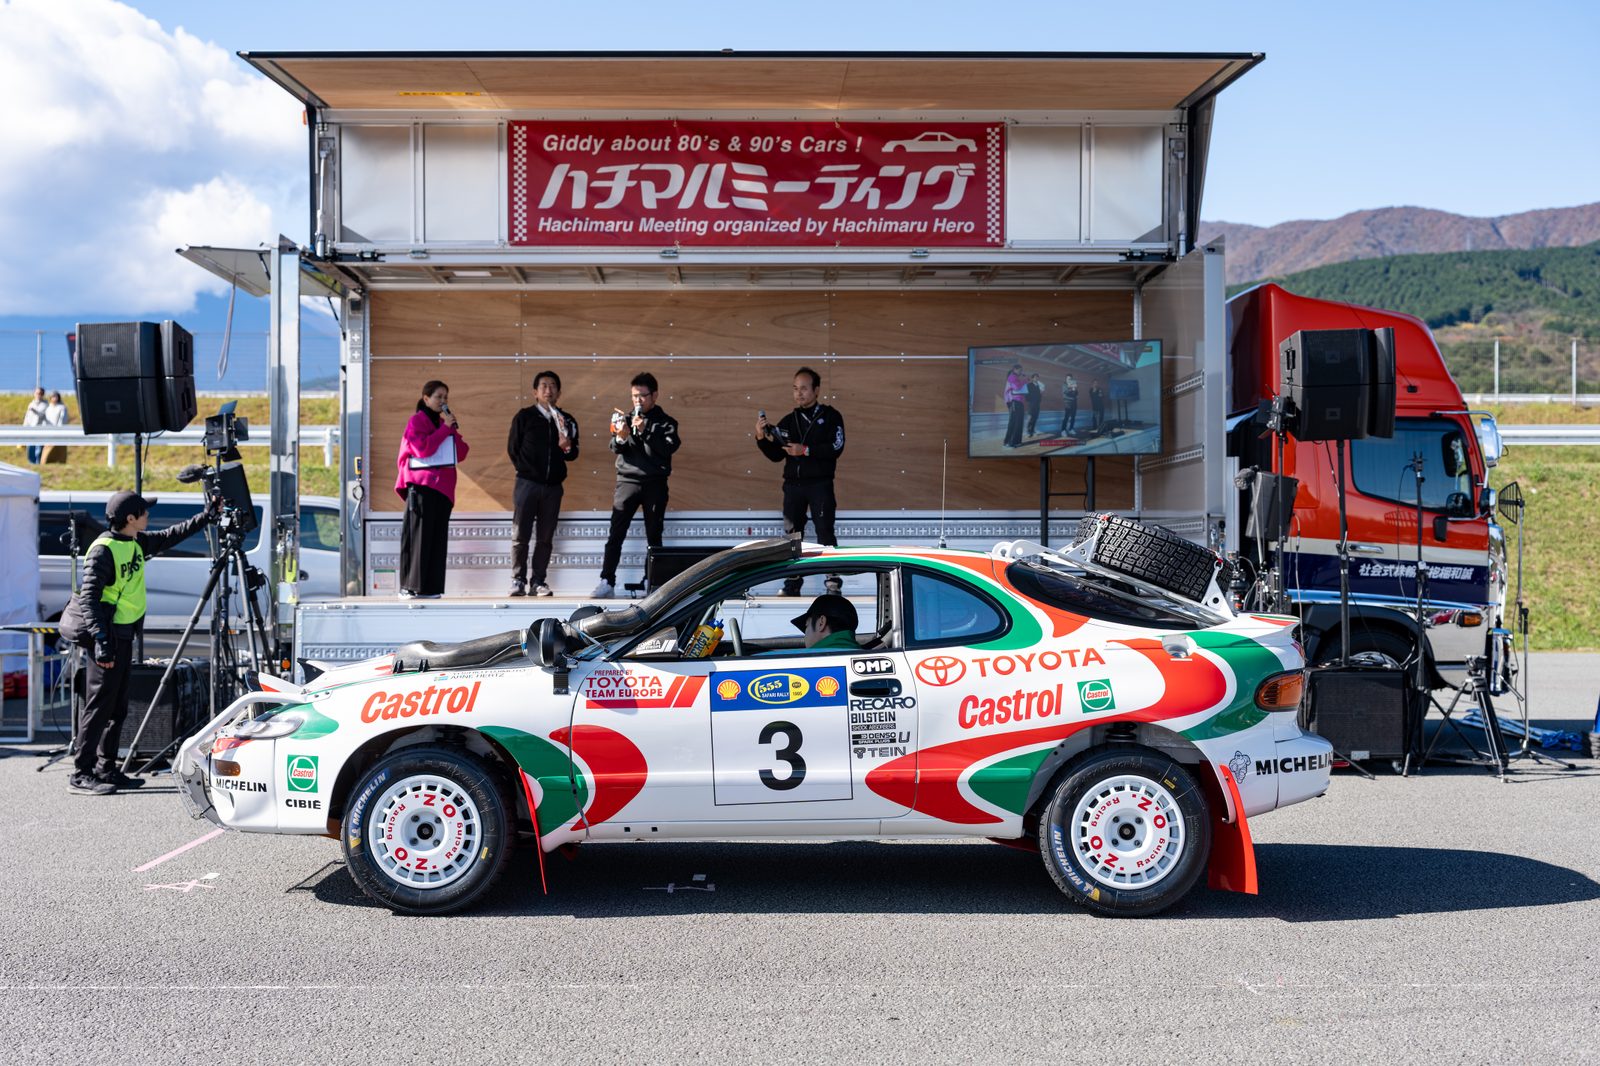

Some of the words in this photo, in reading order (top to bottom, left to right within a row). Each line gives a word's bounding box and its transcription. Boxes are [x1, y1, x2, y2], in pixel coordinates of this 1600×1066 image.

[543, 134, 605, 156] Giddy
[610, 135, 671, 152] about
[727, 136, 742, 152] &
[799, 135, 848, 153] Cars
[854, 136, 863, 153] !
[537, 161, 977, 212] ハチマルミーティング
[537, 217, 634, 233] Hachimaru
[638, 217, 709, 236] Meeting
[712, 217, 802, 236] organized
[805, 217, 828, 236] by
[832, 217, 928, 233] Hachimaru
[932, 217, 975, 233] Hero
[854, 659, 892, 673] OMP
[971, 647, 1106, 678] TOYOTA
[585, 676, 663, 688] TOYOTA
[585, 689, 616, 698] TEAM
[619, 688, 663, 698] EUROPE
[759, 679, 783, 693] 555
[360, 681, 482, 724] Castrol
[850, 696, 917, 711] RECARO
[958, 683, 1064, 730] Castrol
[1086, 689, 1109, 700] Castrol
[850, 711, 896, 724] BILSTEIN
[758, 720, 807, 791] 3
[867, 746, 907, 758] TEIN
[1255, 750, 1334, 776] MICHELIN
[293, 768, 315, 778] Castrol
[215, 778, 268, 793] MICHELIN
[353, 772, 387, 826] MICHELIN
[386, 803, 407, 840] Racing
[1090, 796, 1121, 827] Racing
[444, 821, 464, 860] Racing
[1136, 836, 1166, 868] Racing
[1053, 830, 1085, 887] MICHELIN
